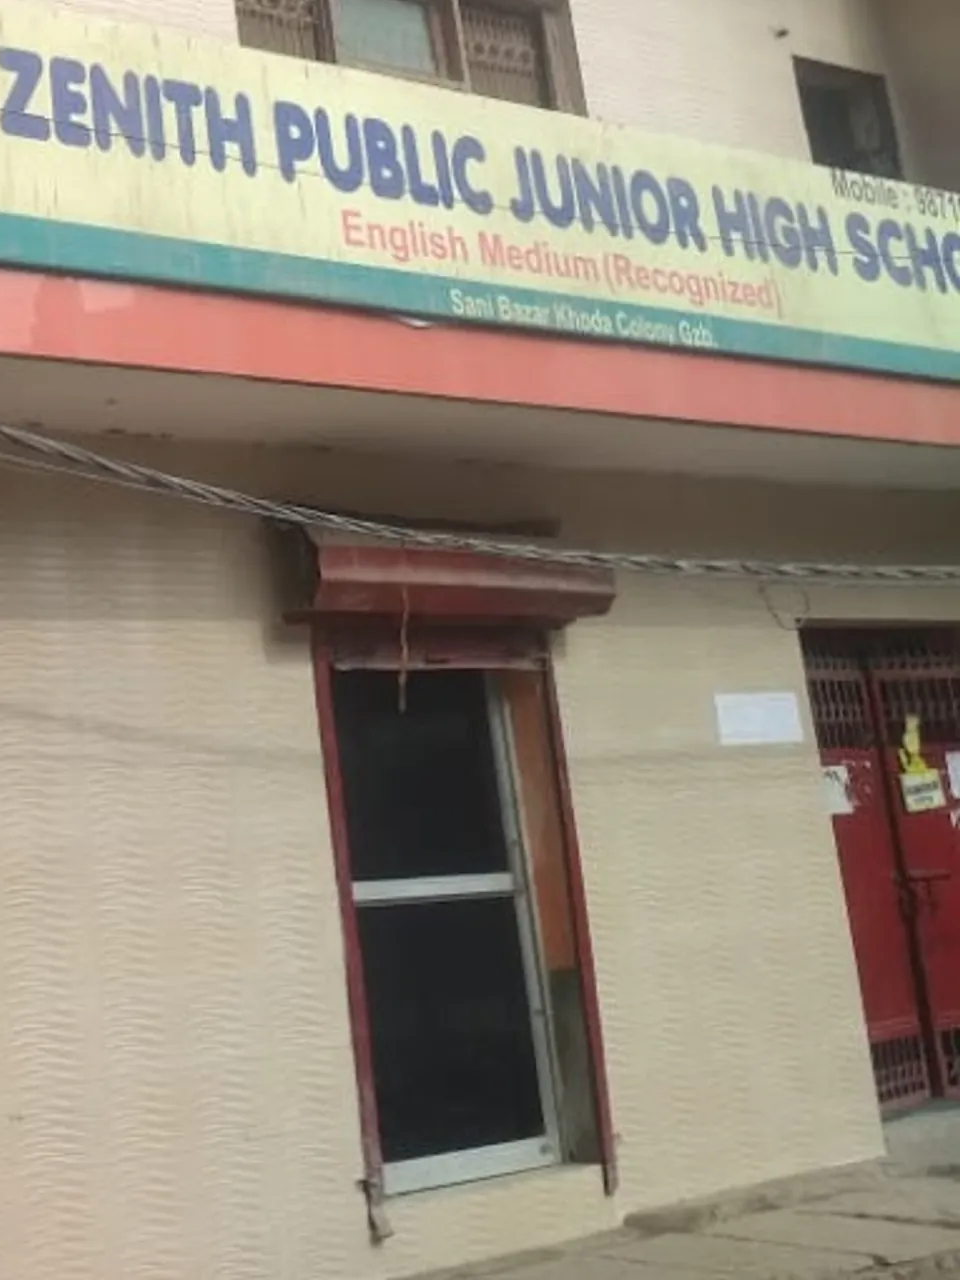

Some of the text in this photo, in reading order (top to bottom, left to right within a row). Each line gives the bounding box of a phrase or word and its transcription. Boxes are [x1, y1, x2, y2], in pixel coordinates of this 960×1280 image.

[273, 101, 493, 215] PUBLIC
[509, 146, 707, 253] JUNIOR
[712, 185, 838, 277] HIGH
[831, 167, 899, 210] Mobile
[914, 186, 960, 223] 9871
[341, 209, 468, 263] English
[479, 230, 601, 284] Medium
[450, 288, 492, 316] Sani
